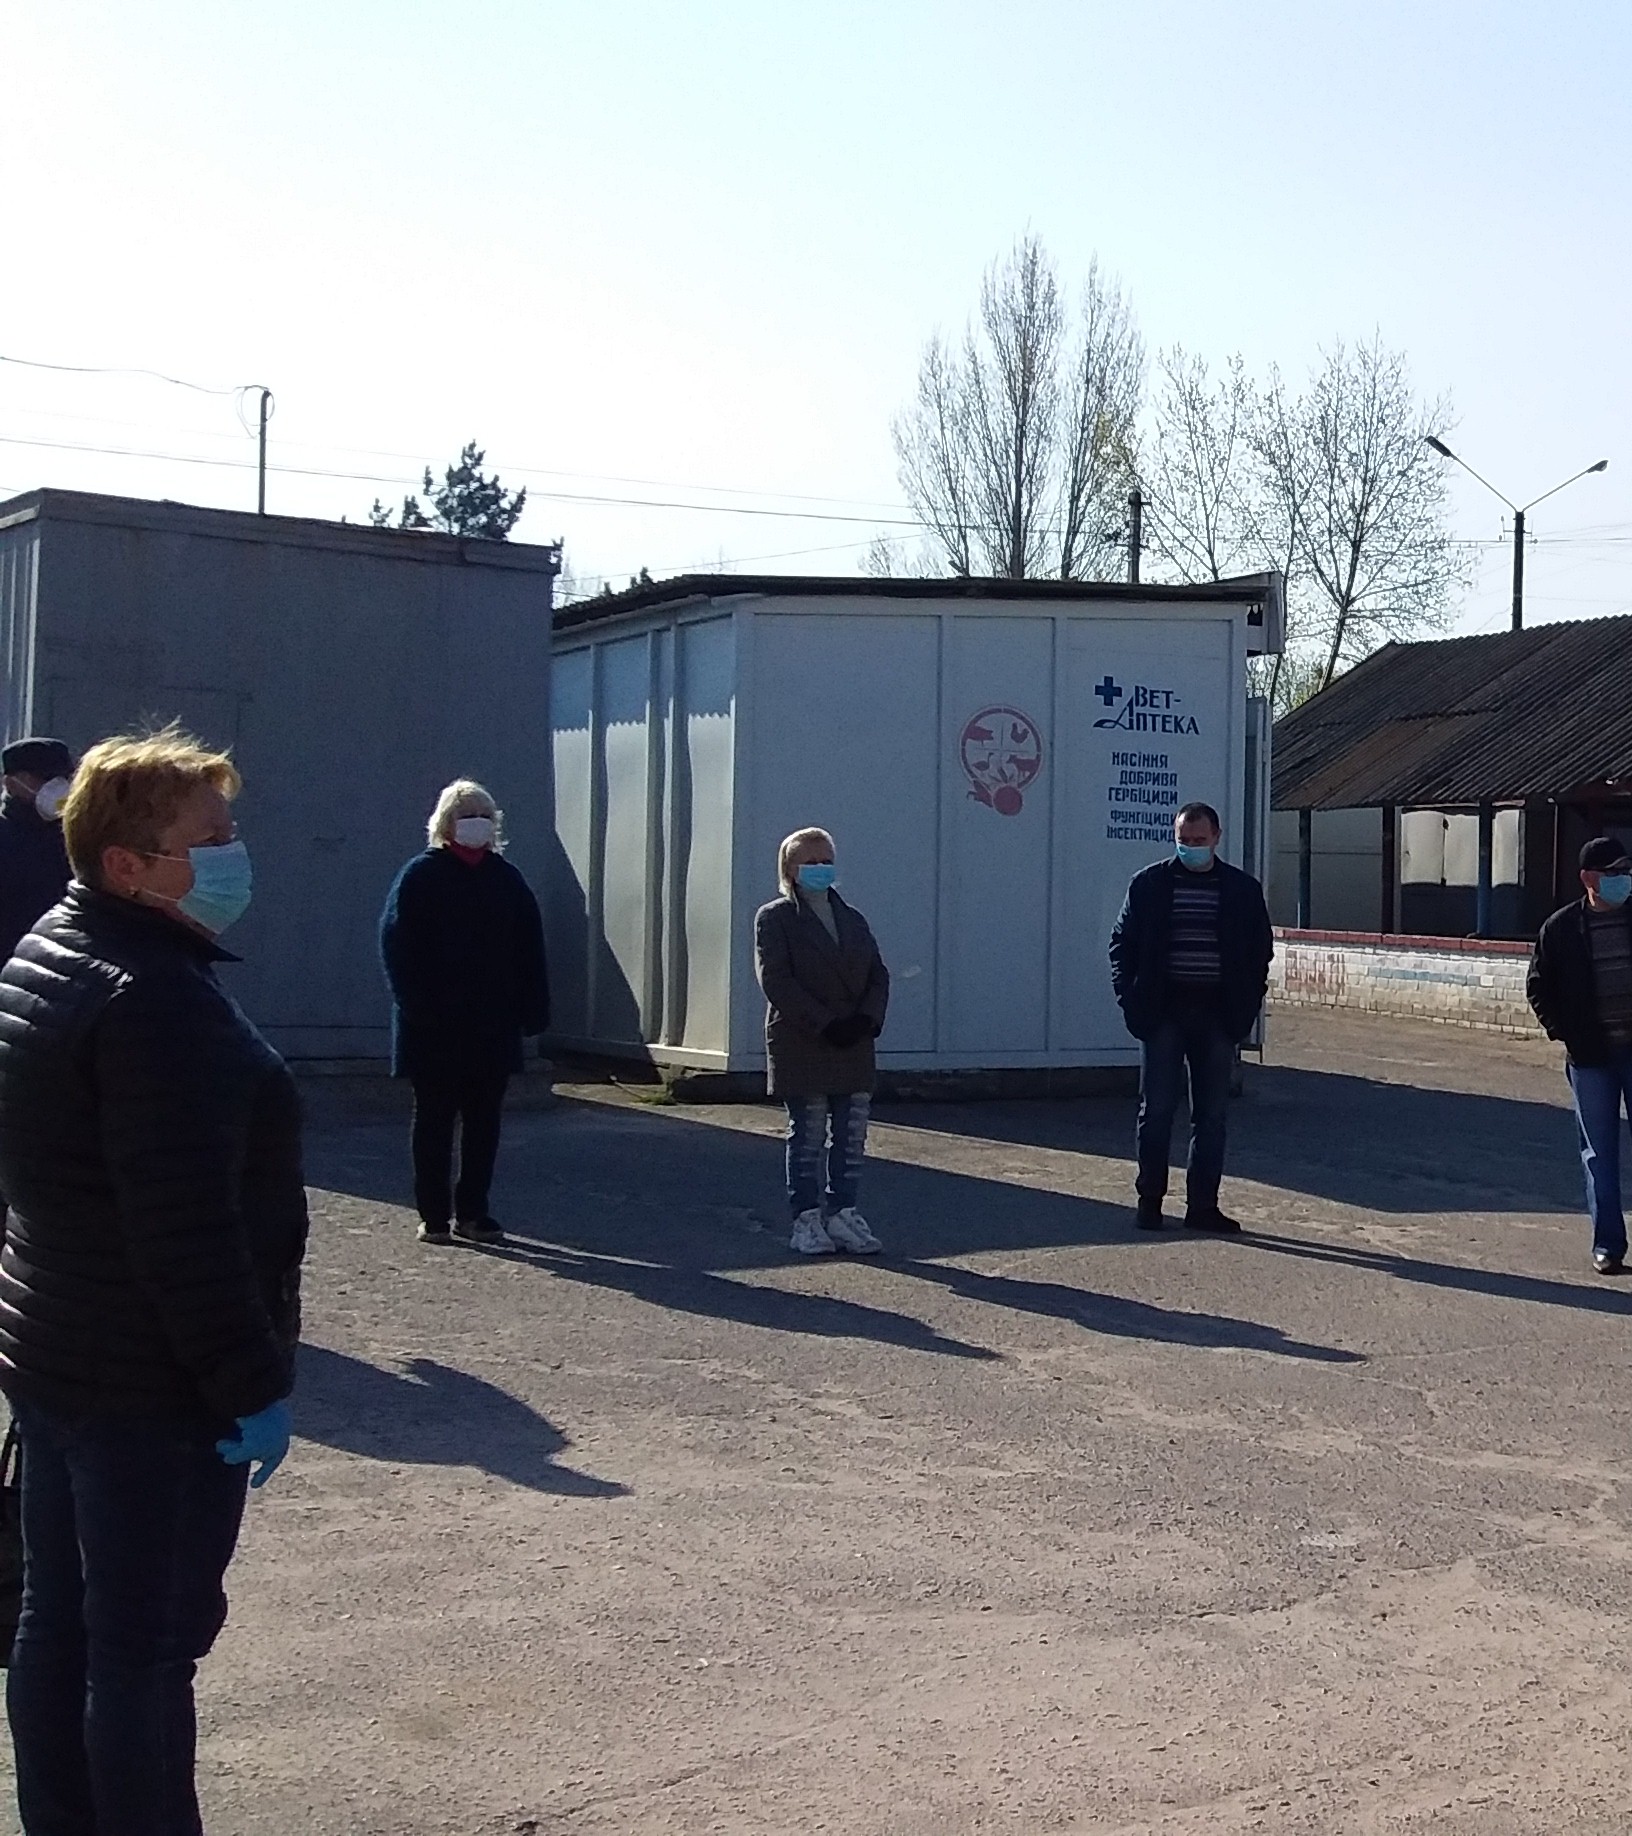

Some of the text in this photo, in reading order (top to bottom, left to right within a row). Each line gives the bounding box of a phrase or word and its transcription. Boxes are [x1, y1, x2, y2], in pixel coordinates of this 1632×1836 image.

[1134, 685, 1181, 709] ВЕТ-
[1093, 696, 1200, 735] АПТЕКА
[1119, 770, 1178, 787] ДОБРИВА
[1108, 787, 1178, 806] ГЕРБІЦИДИ
[1106, 825, 1175, 843] ІНСЕКТИЦИД
